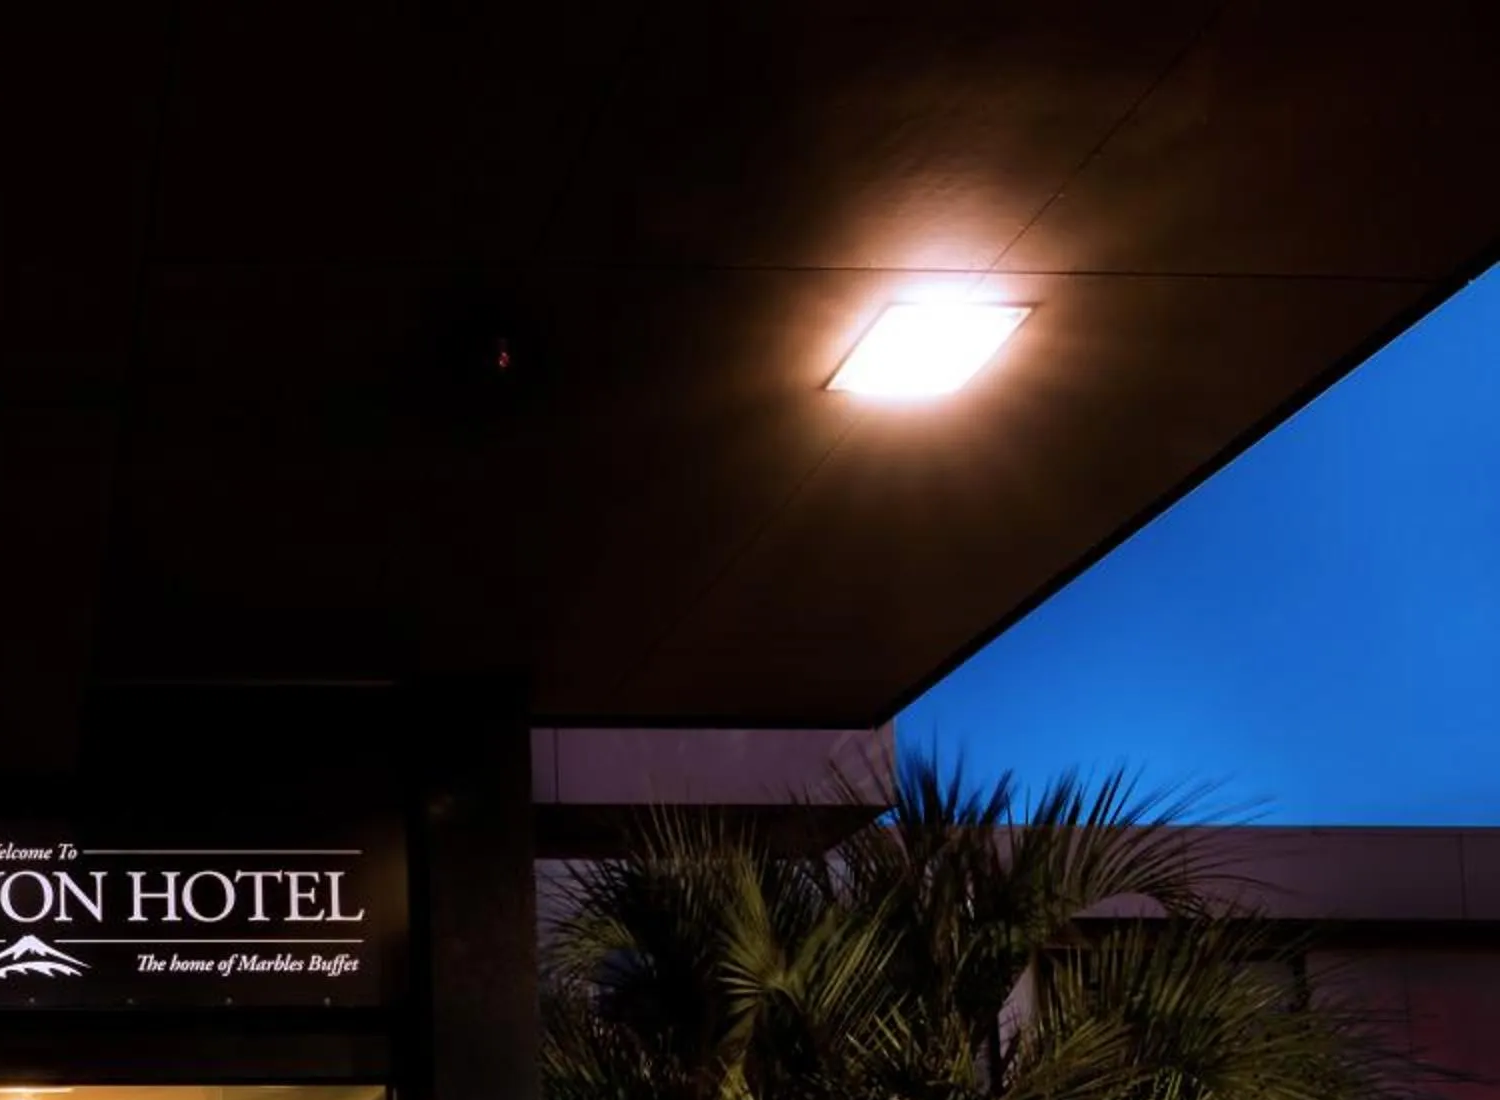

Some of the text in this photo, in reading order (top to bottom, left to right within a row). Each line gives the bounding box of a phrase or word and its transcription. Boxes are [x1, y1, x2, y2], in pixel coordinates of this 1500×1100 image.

[58, 842, 78, 860] To
[127, 869, 366, 923] HOTEL
[137, 953, 359, 976] The home of Marbles Buffet
